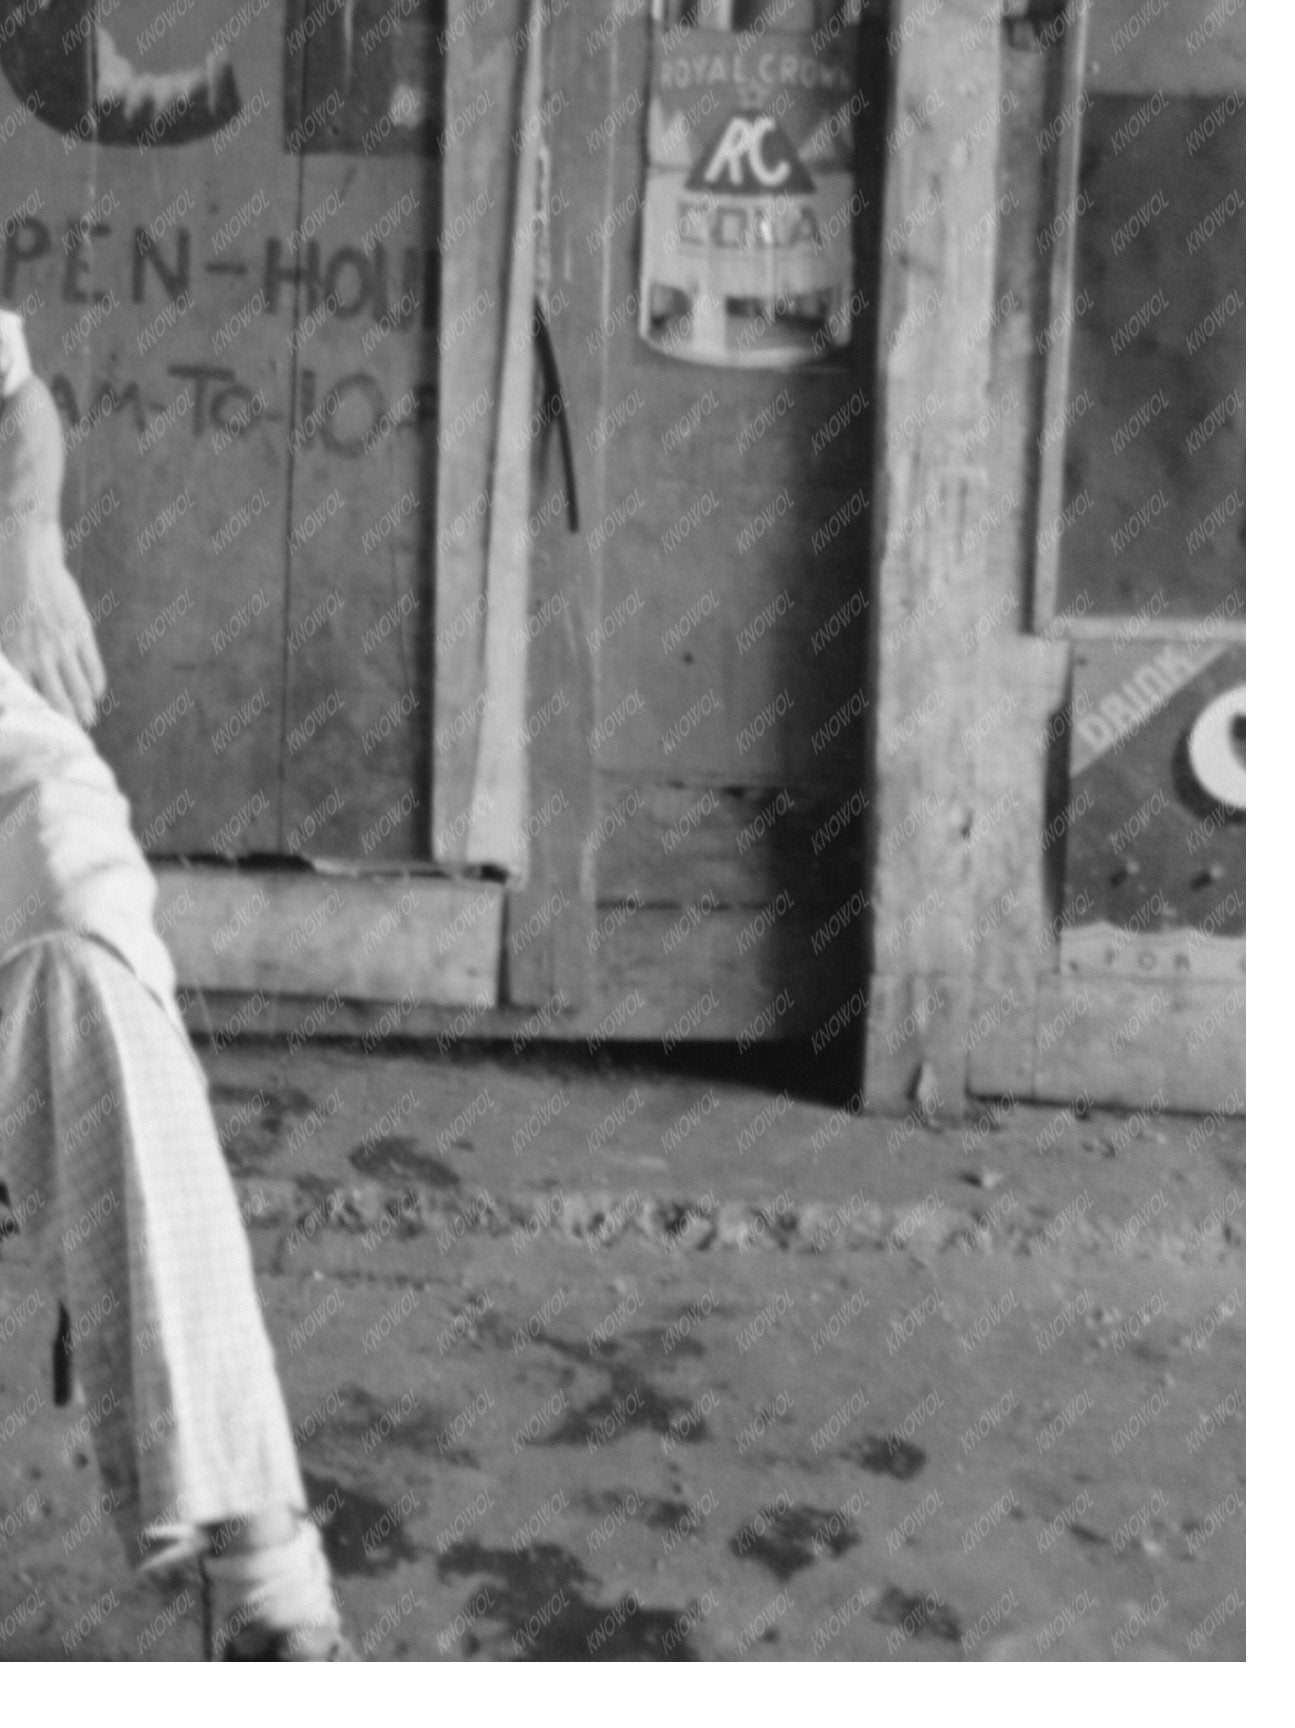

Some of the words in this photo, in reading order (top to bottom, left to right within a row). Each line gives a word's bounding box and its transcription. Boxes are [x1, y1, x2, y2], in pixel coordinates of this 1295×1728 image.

[661, 57, 750, 88] ROYAL
[678, 204, 821, 249] COLA
[1074, 644, 1212, 752] DRINK
